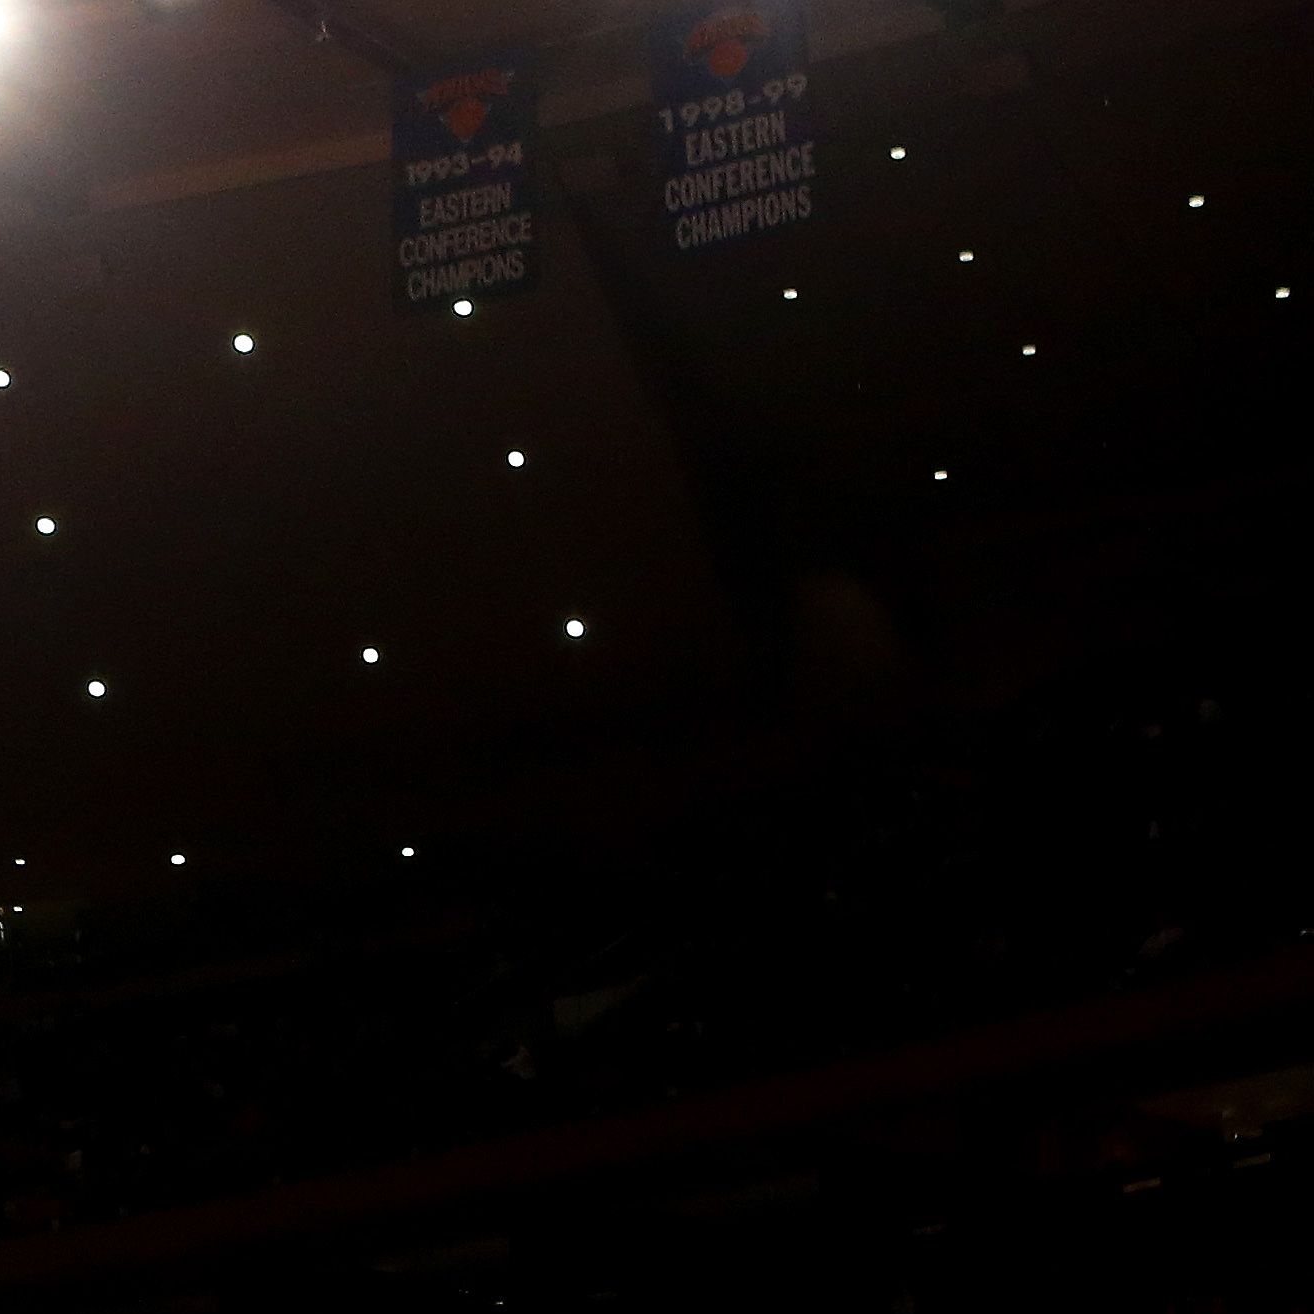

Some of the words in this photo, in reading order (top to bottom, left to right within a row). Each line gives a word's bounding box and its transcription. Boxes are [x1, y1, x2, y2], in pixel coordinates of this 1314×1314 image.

[658, 73, 808, 133] 1998-99
[685, 109, 786, 166] EASTERN
[419, 182, 511, 228] EASTERN
[664, 141, 816, 212] CONFERENCE
[399, 211, 532, 267] CONFERENCE
[675, 184, 813, 250] CHAMPIONS
[407, 249, 525, 301] CHAMPIONS
